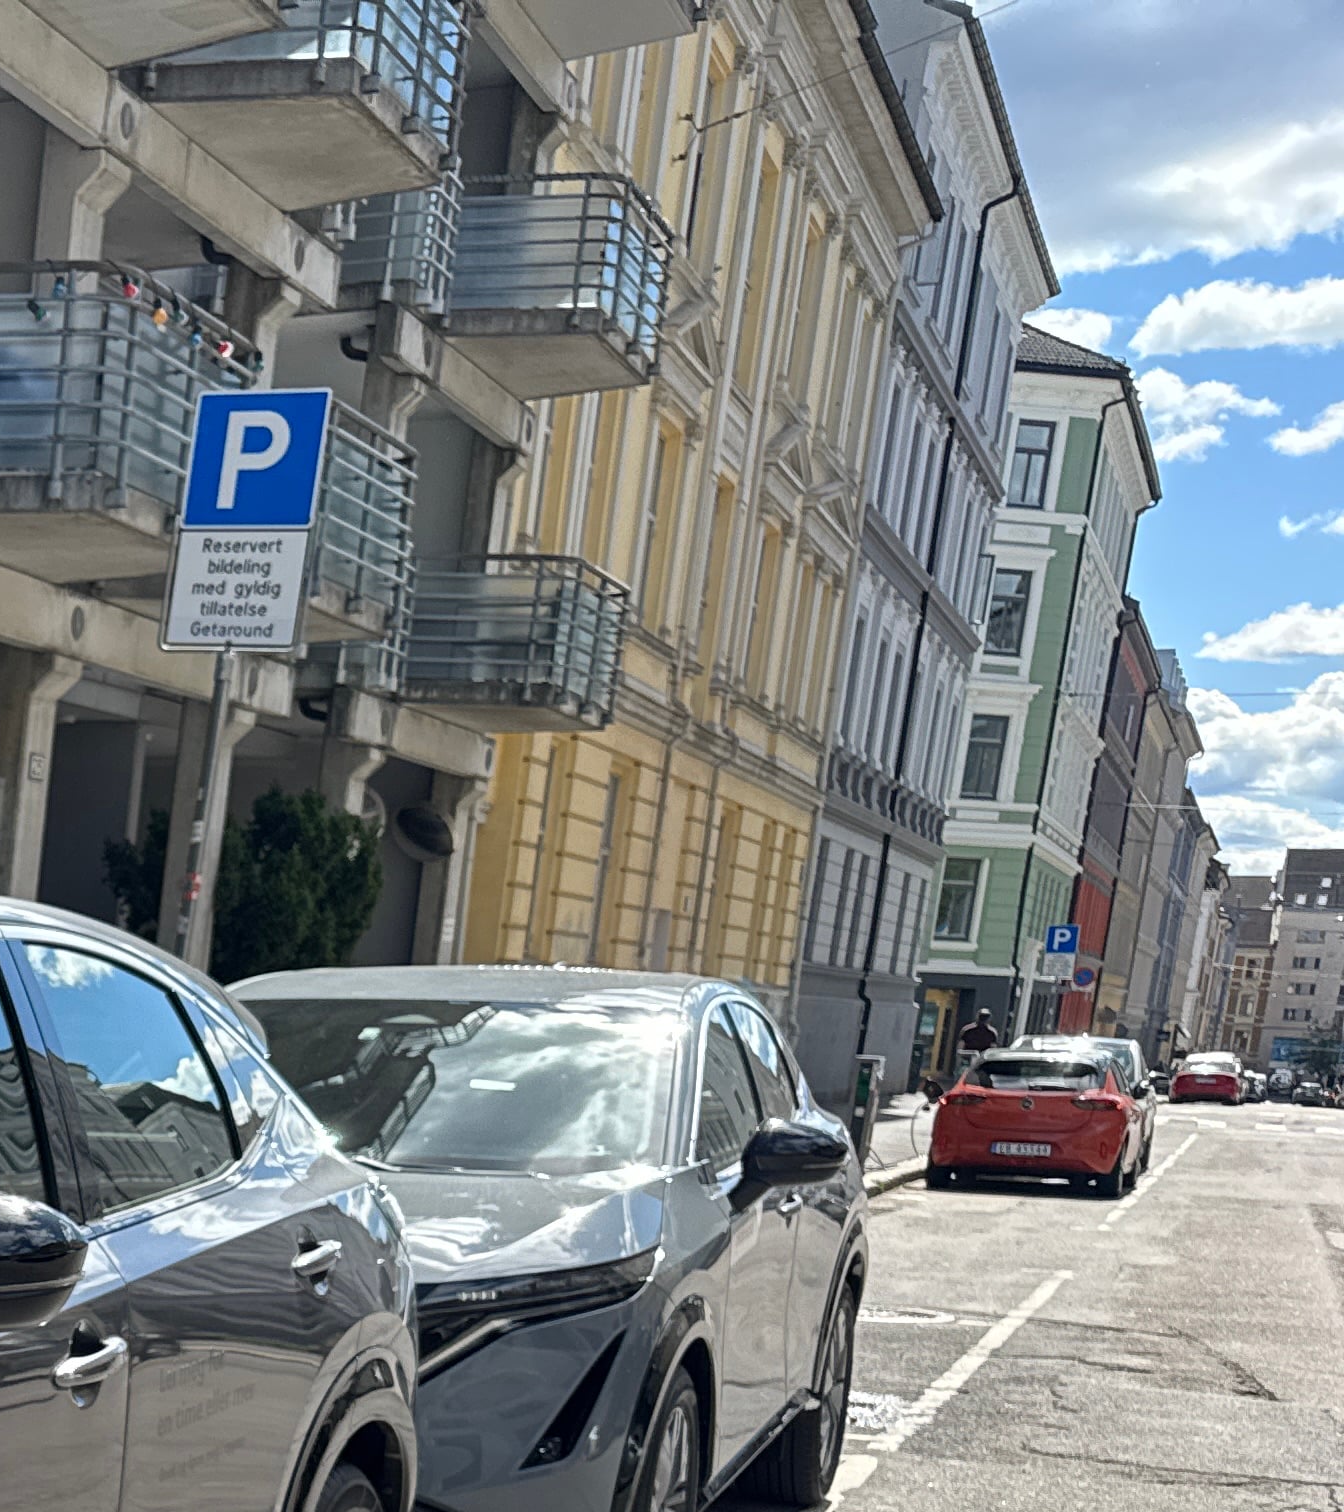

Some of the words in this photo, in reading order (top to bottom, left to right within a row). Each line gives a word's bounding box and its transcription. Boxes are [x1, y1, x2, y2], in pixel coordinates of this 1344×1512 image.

[216, 410, 291, 509] P
[202, 538, 282, 553] Reservert
[207, 558, 271, 578] bildeling
[192, 580, 226, 595] med
[234, 580, 281, 600] gyldig
[200, 600, 268, 617] tillatelse
[190, 621, 274, 637] Getaround
[1053, 928, 1072, 951] P
